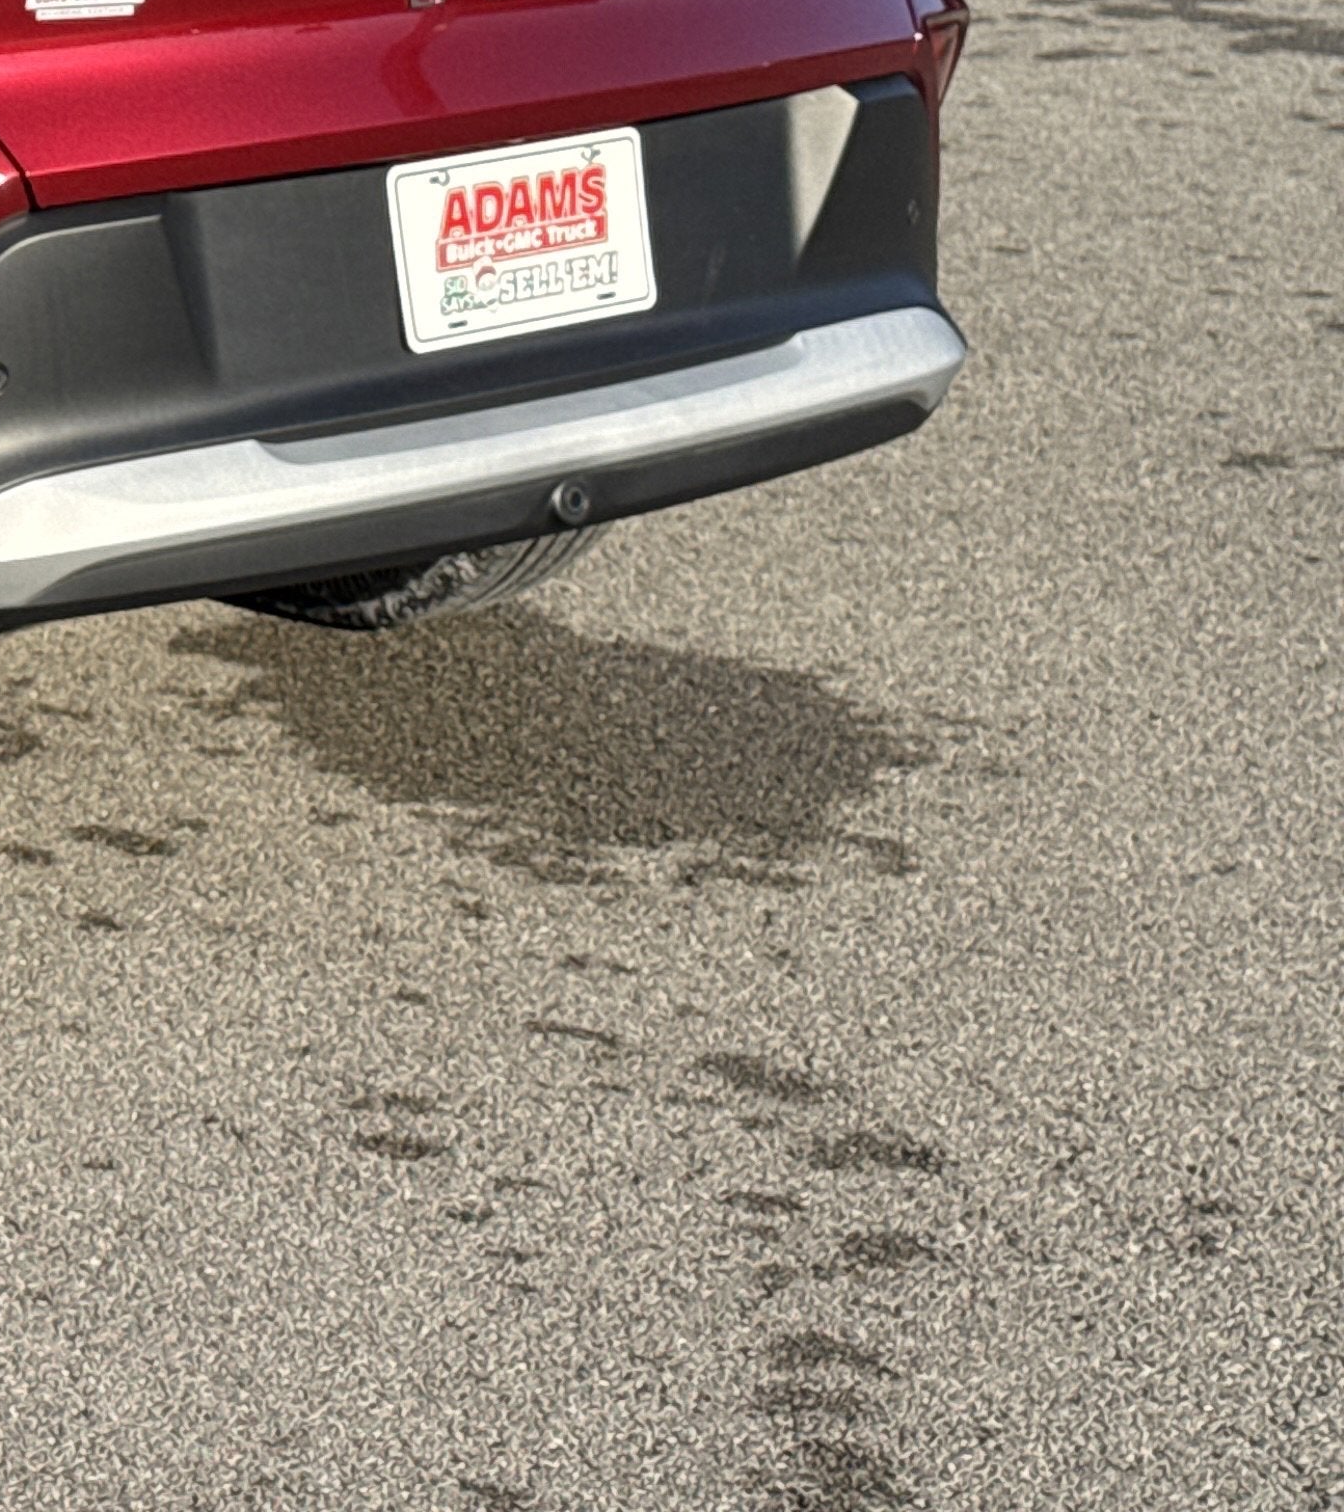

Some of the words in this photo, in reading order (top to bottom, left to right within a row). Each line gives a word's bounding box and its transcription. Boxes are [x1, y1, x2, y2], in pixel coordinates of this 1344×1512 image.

[440, 164, 606, 240] ADAMS
[547, 219, 599, 246] Truck
[498, 263, 564, 305] SELL
